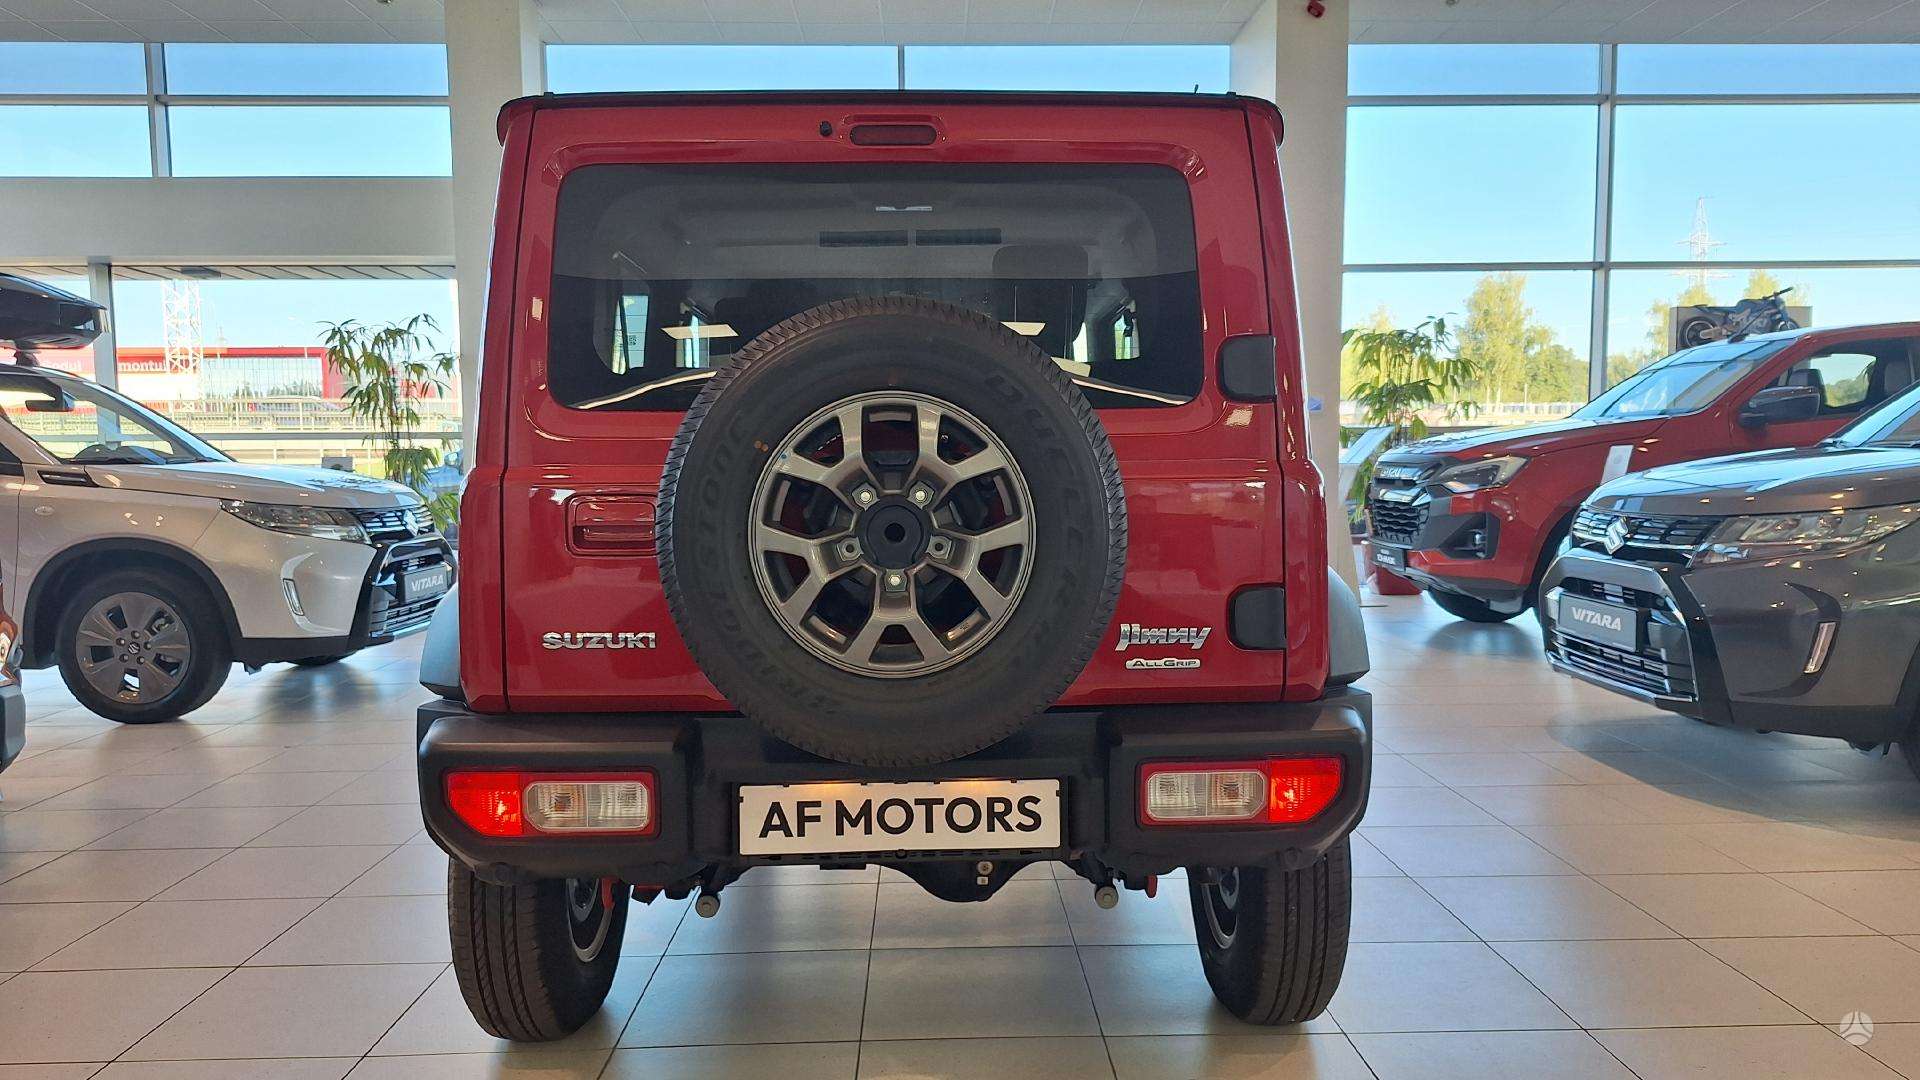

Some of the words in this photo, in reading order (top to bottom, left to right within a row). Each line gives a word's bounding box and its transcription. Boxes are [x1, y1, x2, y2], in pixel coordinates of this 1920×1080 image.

[411, 574, 444, 592] VITARA
[1571, 606, 1621, 631] VITARA
[542, 632, 656, 649] SUZUKI
[1115, 623, 1211, 651] Jimny
[758, 801, 822, 839] AF
[835, 795, 1042, 836] MOTORS
